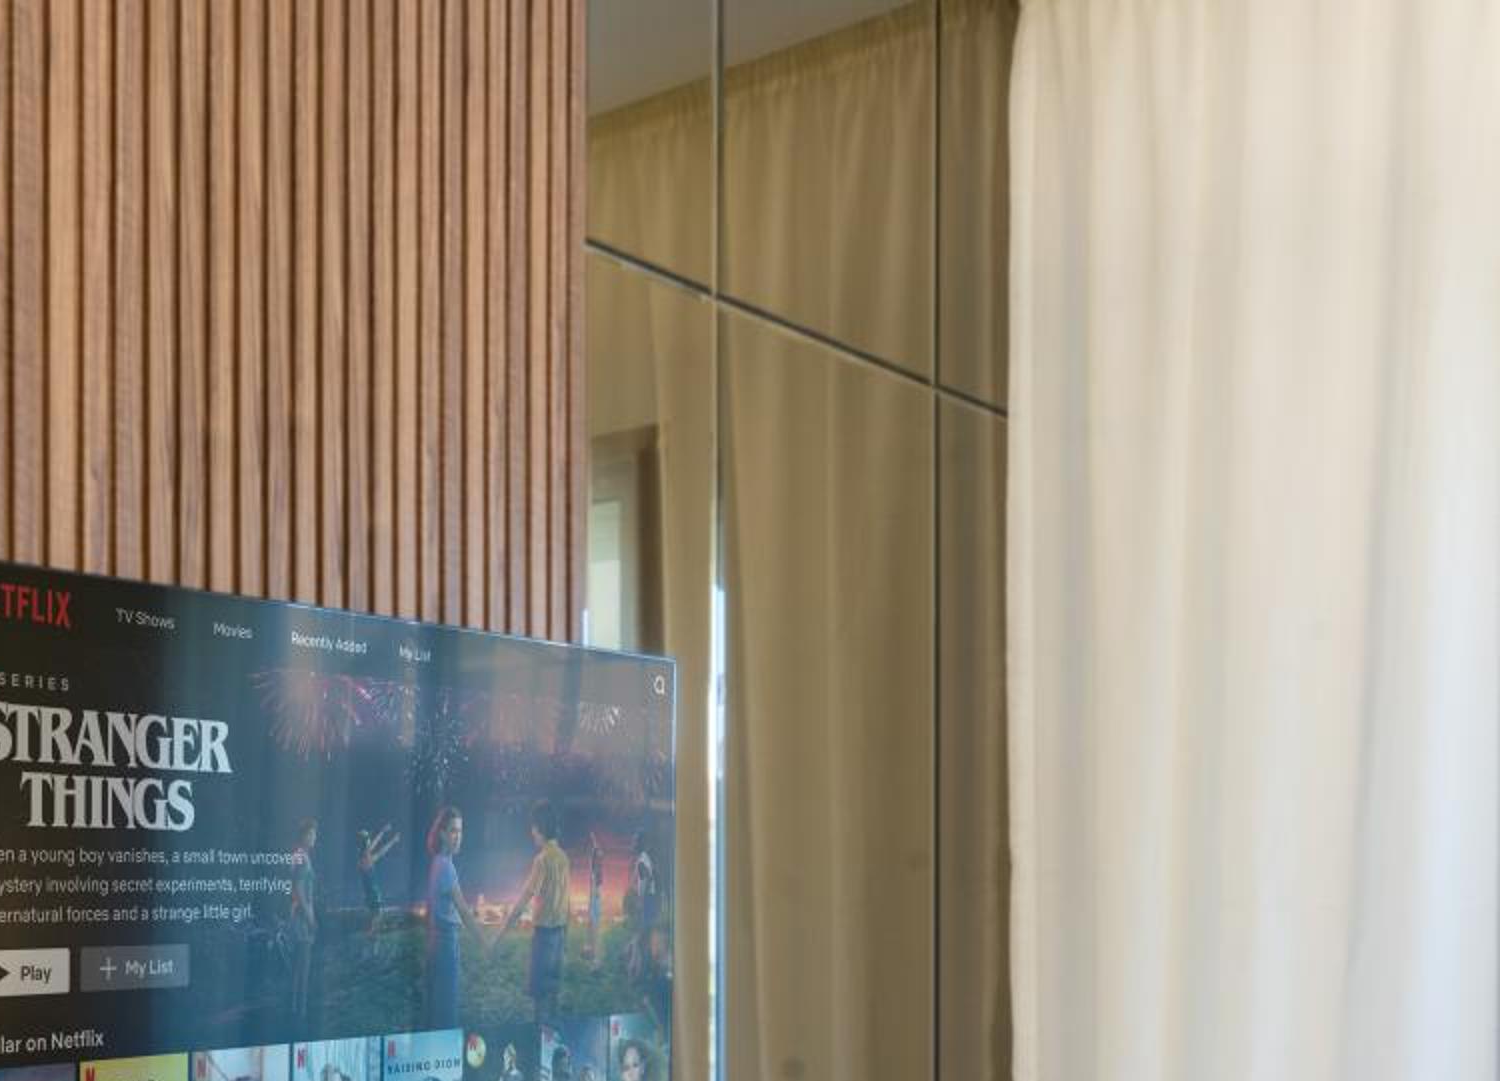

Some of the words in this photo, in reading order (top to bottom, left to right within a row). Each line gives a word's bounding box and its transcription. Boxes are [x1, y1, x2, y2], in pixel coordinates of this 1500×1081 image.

[115, 607, 133, 624] TV
[134, 611, 175, 630] Shows
[213, 622, 253, 640] Movies
[291, 631, 333, 650] Recently
[335, 637, 367, 655] Added
[20, 771, 196, 831] THINGS
[18, 849, 28, 862] a
[31, 848, 75, 868] young
[79, 848, 105, 865] boy
[107, 848, 169, 865] vanishes,
[171, 850, 181, 863] a
[183, 848, 215, 864] small
[217, 850, 249, 864] town
[45, 876, 109, 896] involving
[111, 877, 153, 893] secret
[155, 877, 237, 895] experiments,
[239, 876, 292, 895] terrifying
[66, 905, 109, 922] forces
[112, 905, 138, 922] and
[140, 907, 149, 921] a
[151, 905, 200, 923] strange
[202, 904, 229, 920] little
[20, 965, 52, 984] Play
[125, 959, 145, 978] My
[149, 958, 174, 976] List
[26, 1034, 47, 1051] on
[51, 1030, 104, 1049] Netflix
